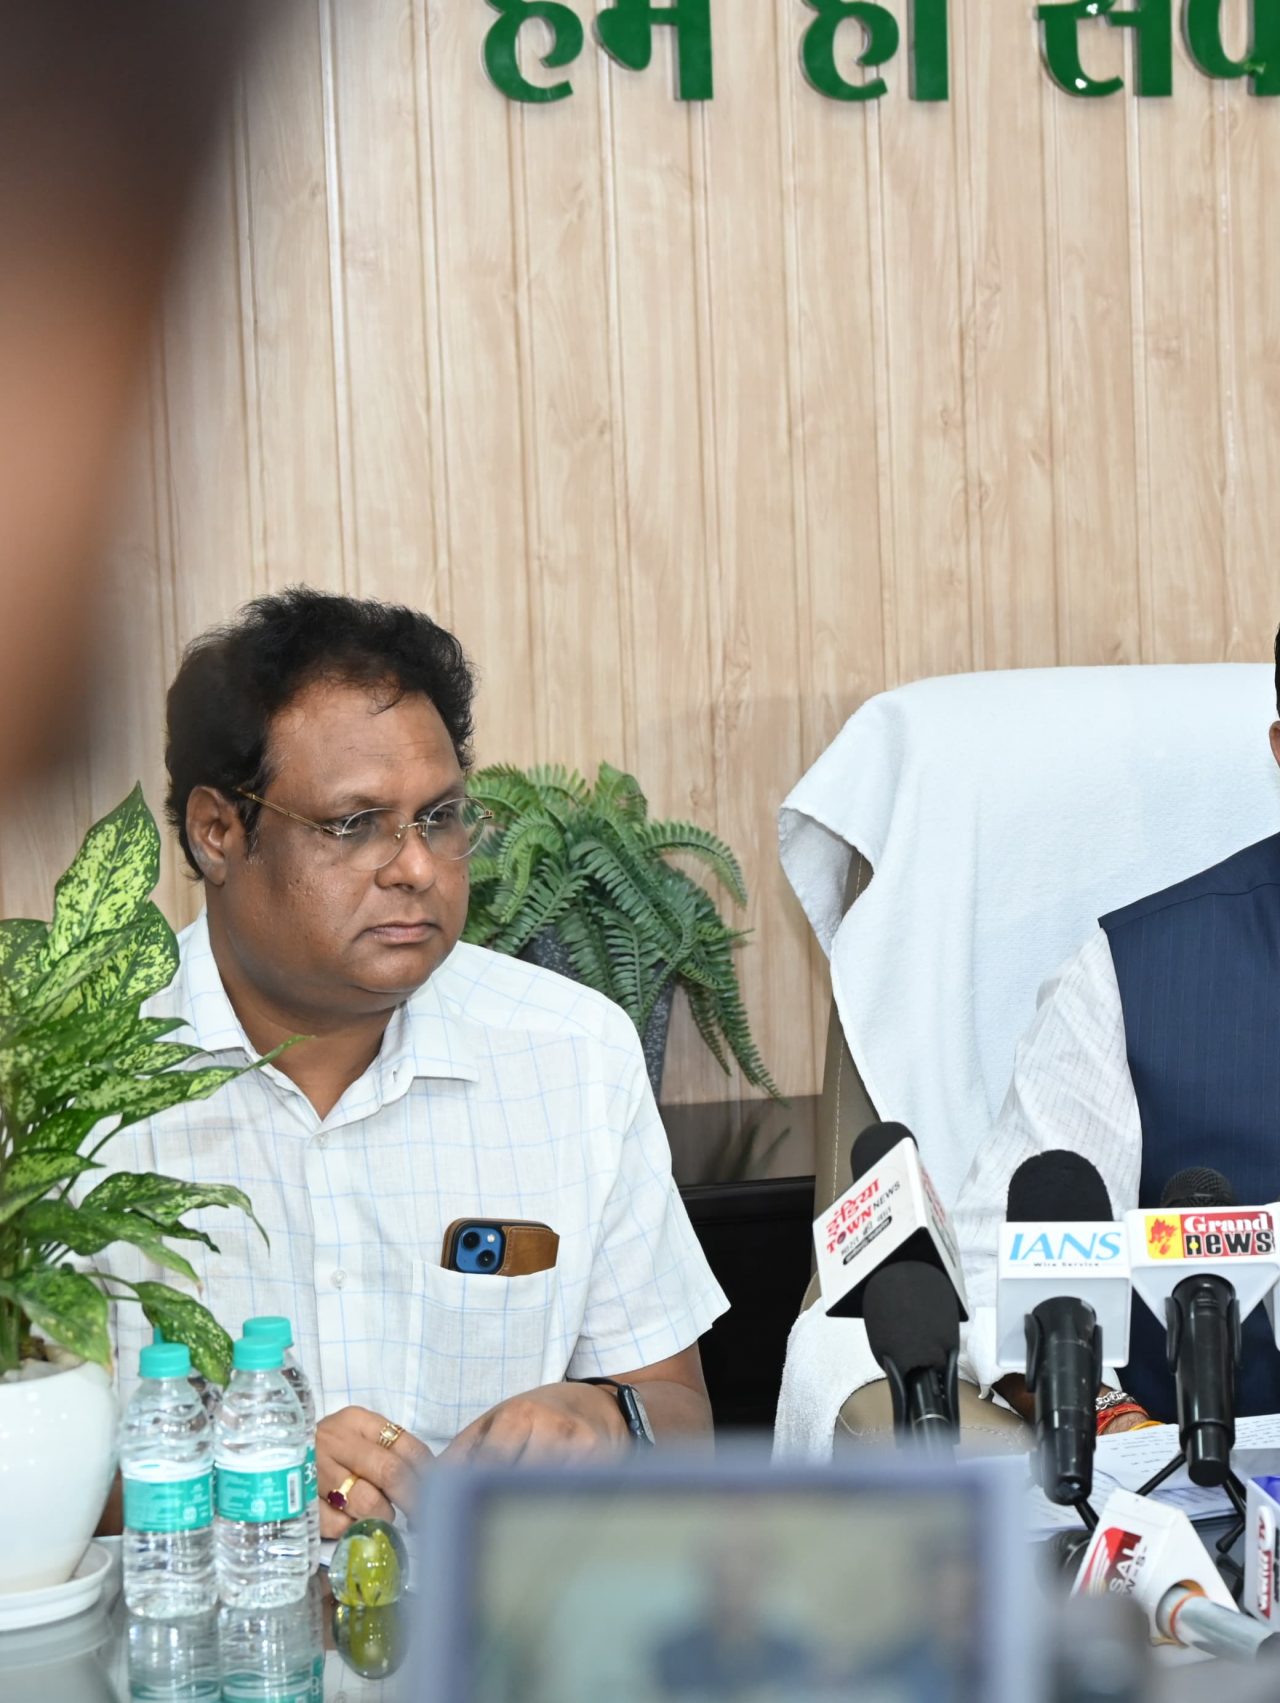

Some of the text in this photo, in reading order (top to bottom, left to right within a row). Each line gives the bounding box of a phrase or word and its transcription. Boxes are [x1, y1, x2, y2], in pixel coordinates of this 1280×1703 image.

[826, 1204, 873, 1254] TOWN
[873, 1180, 901, 1211] NEWS
[1184, 1212, 1270, 1234] Grand
[1009, 1232, 1121, 1261] IANS
[1185, 1231, 1275, 1258] news
